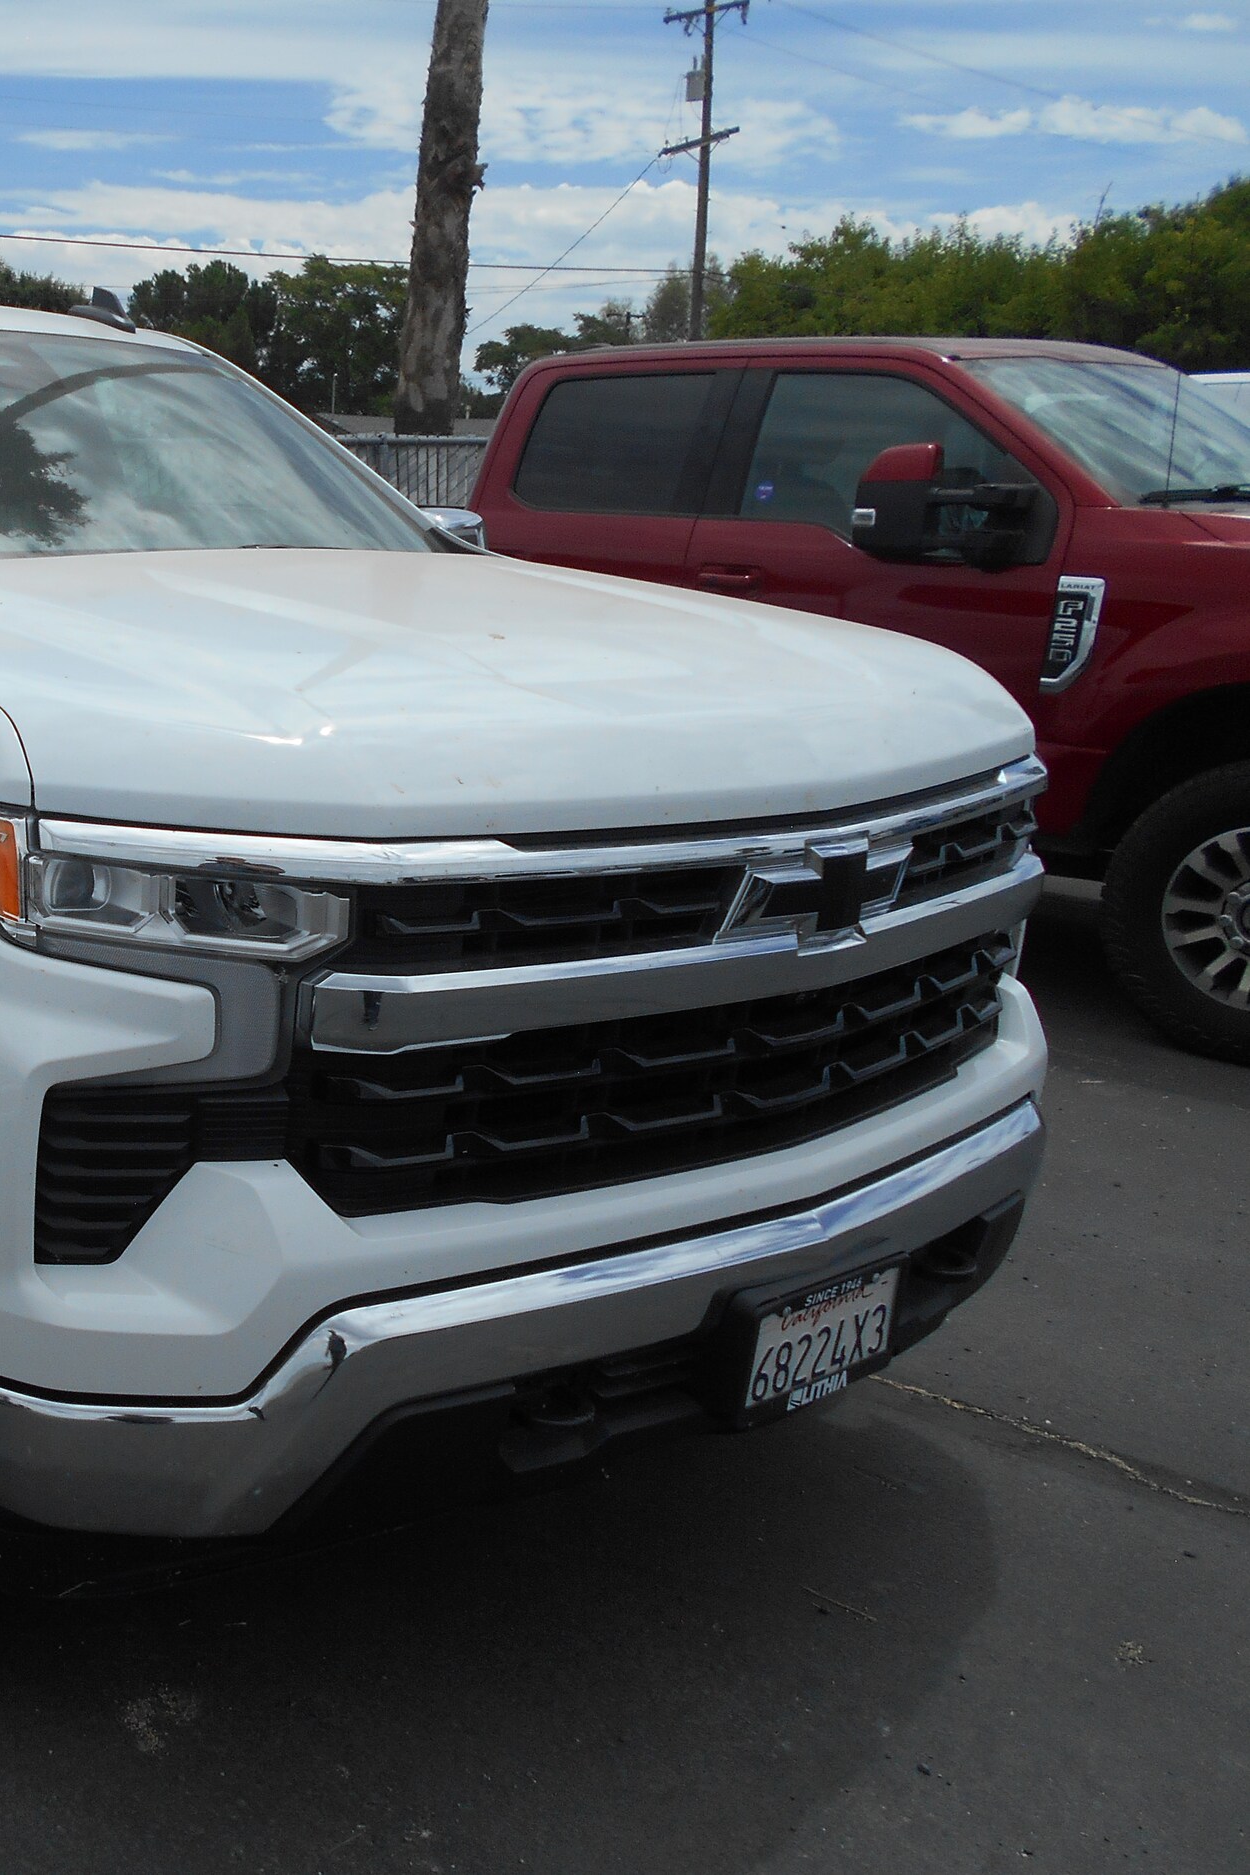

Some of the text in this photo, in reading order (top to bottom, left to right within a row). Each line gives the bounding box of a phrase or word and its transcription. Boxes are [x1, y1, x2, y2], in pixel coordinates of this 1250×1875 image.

[804, 1288, 838, 1307] SINCE
[752, 1304, 887, 1401] 68224X3
[800, 1370, 848, 1404] LITHIA
